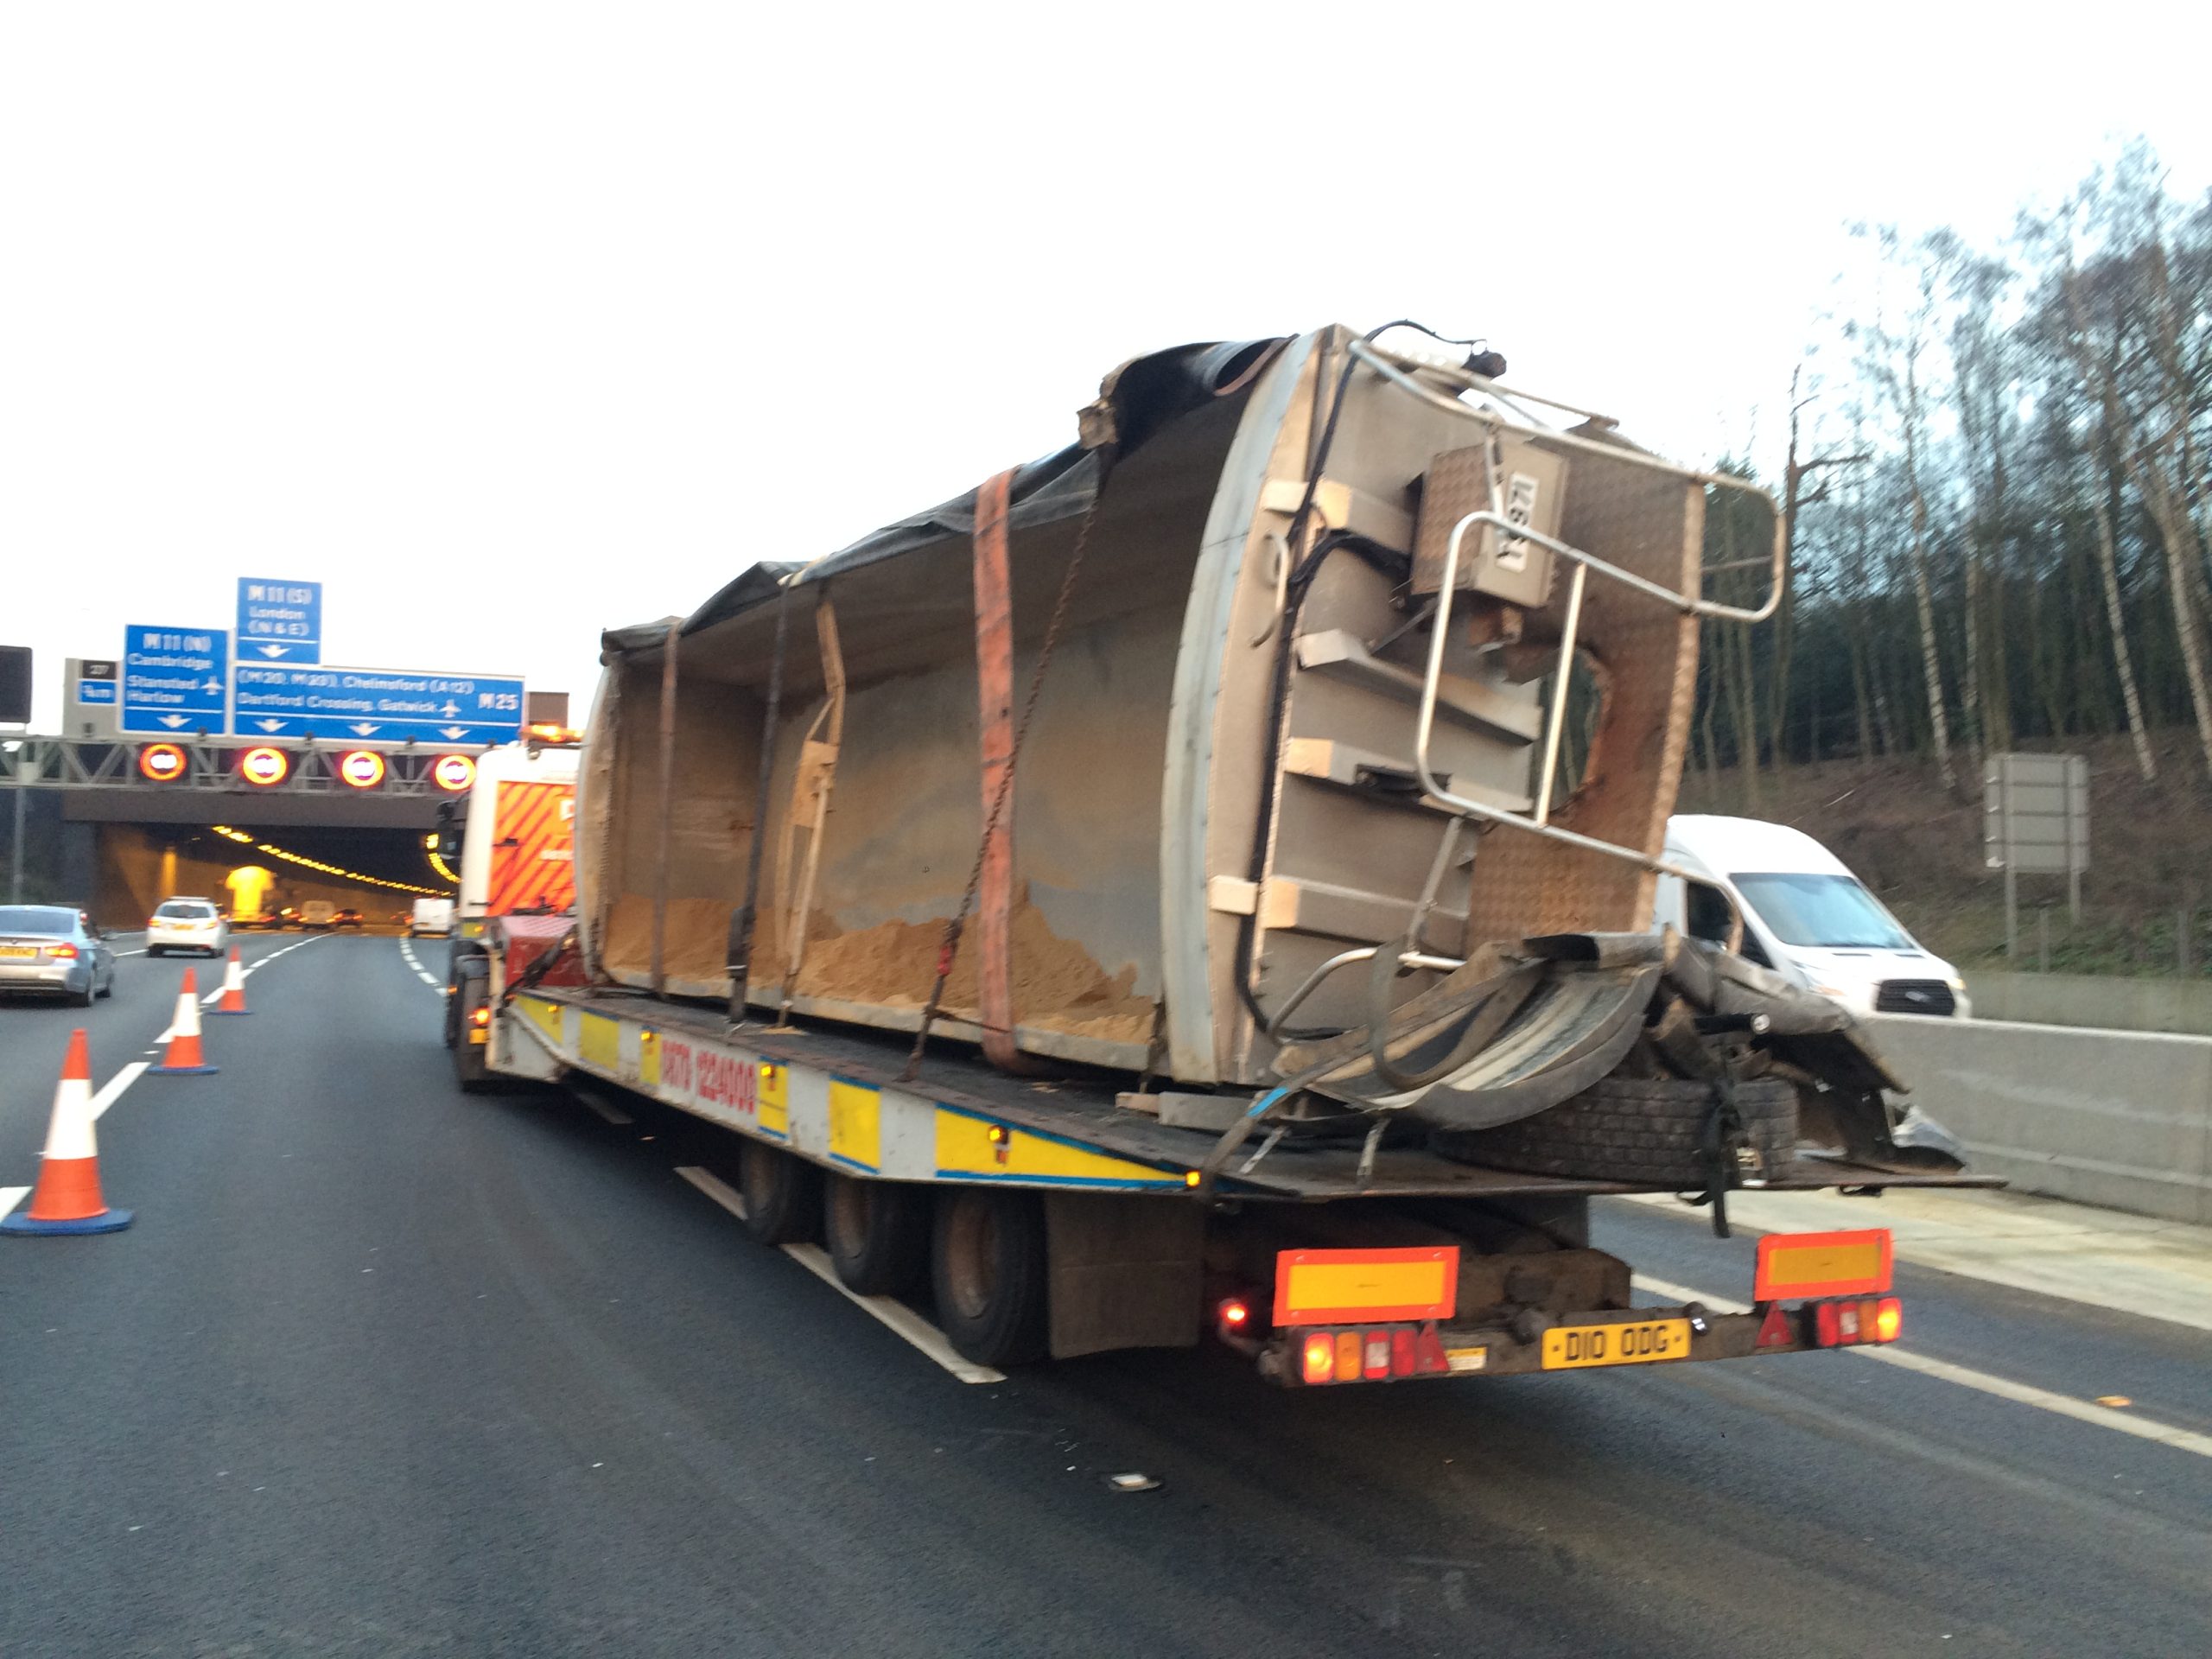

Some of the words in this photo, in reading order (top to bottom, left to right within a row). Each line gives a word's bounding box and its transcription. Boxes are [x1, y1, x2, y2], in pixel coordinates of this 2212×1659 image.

[249, 607, 305, 620] London
[128, 652, 213, 671] Cambridge
[127, 675, 199, 690] Stansted
[342, 676, 428, 692] Chelmsford
[127, 690, 185, 703] Harlow
[237, 692, 304, 707] Dartford
[378, 699, 437, 713] Gatwick
[478, 693, 519, 710] M25
